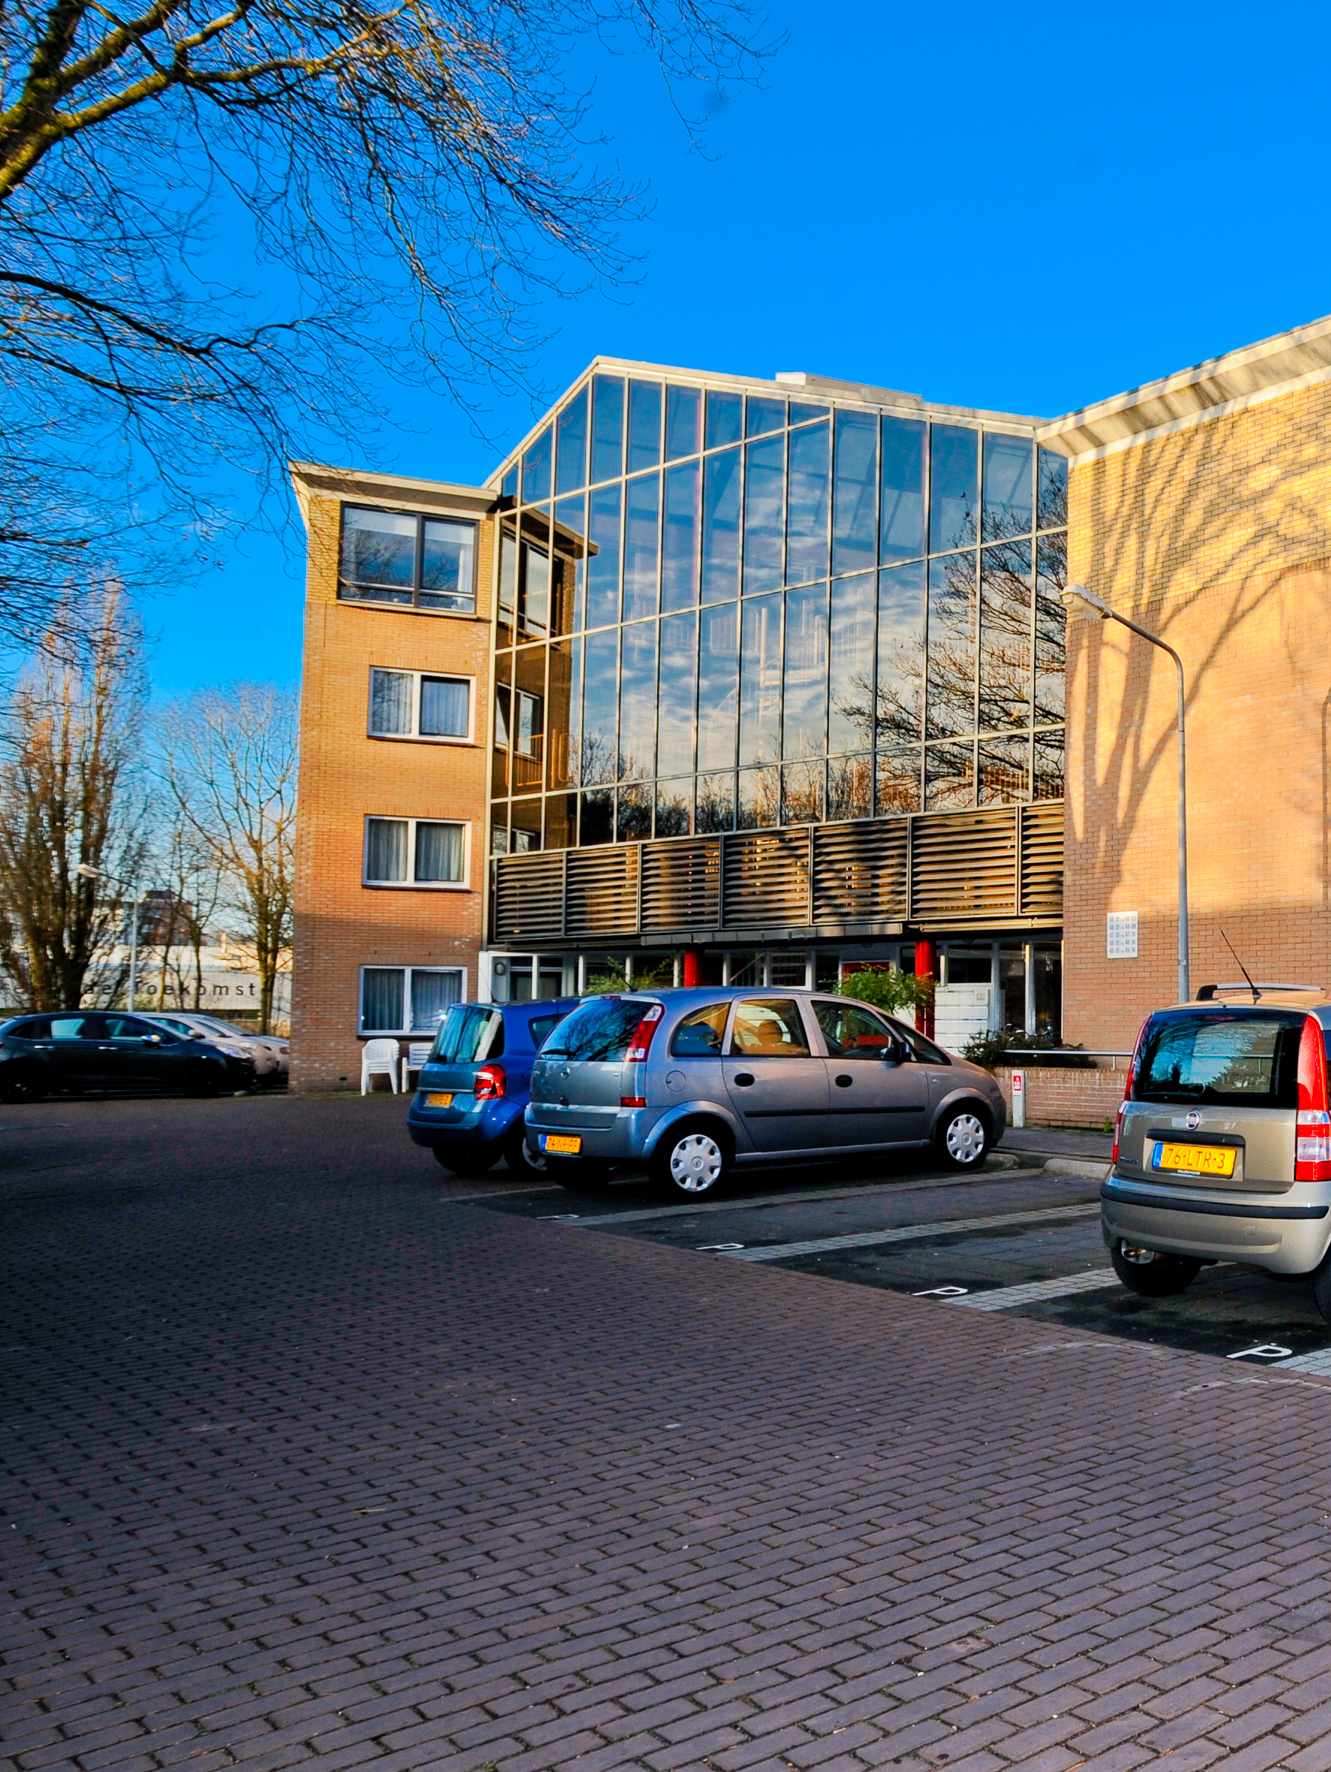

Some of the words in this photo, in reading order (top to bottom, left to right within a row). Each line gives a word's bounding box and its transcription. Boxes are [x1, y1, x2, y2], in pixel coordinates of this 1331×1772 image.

[695, 1242, 744, 1250] P
[911, 1286, 968, 1296] P
[1226, 1345, 1293, 1359] P
